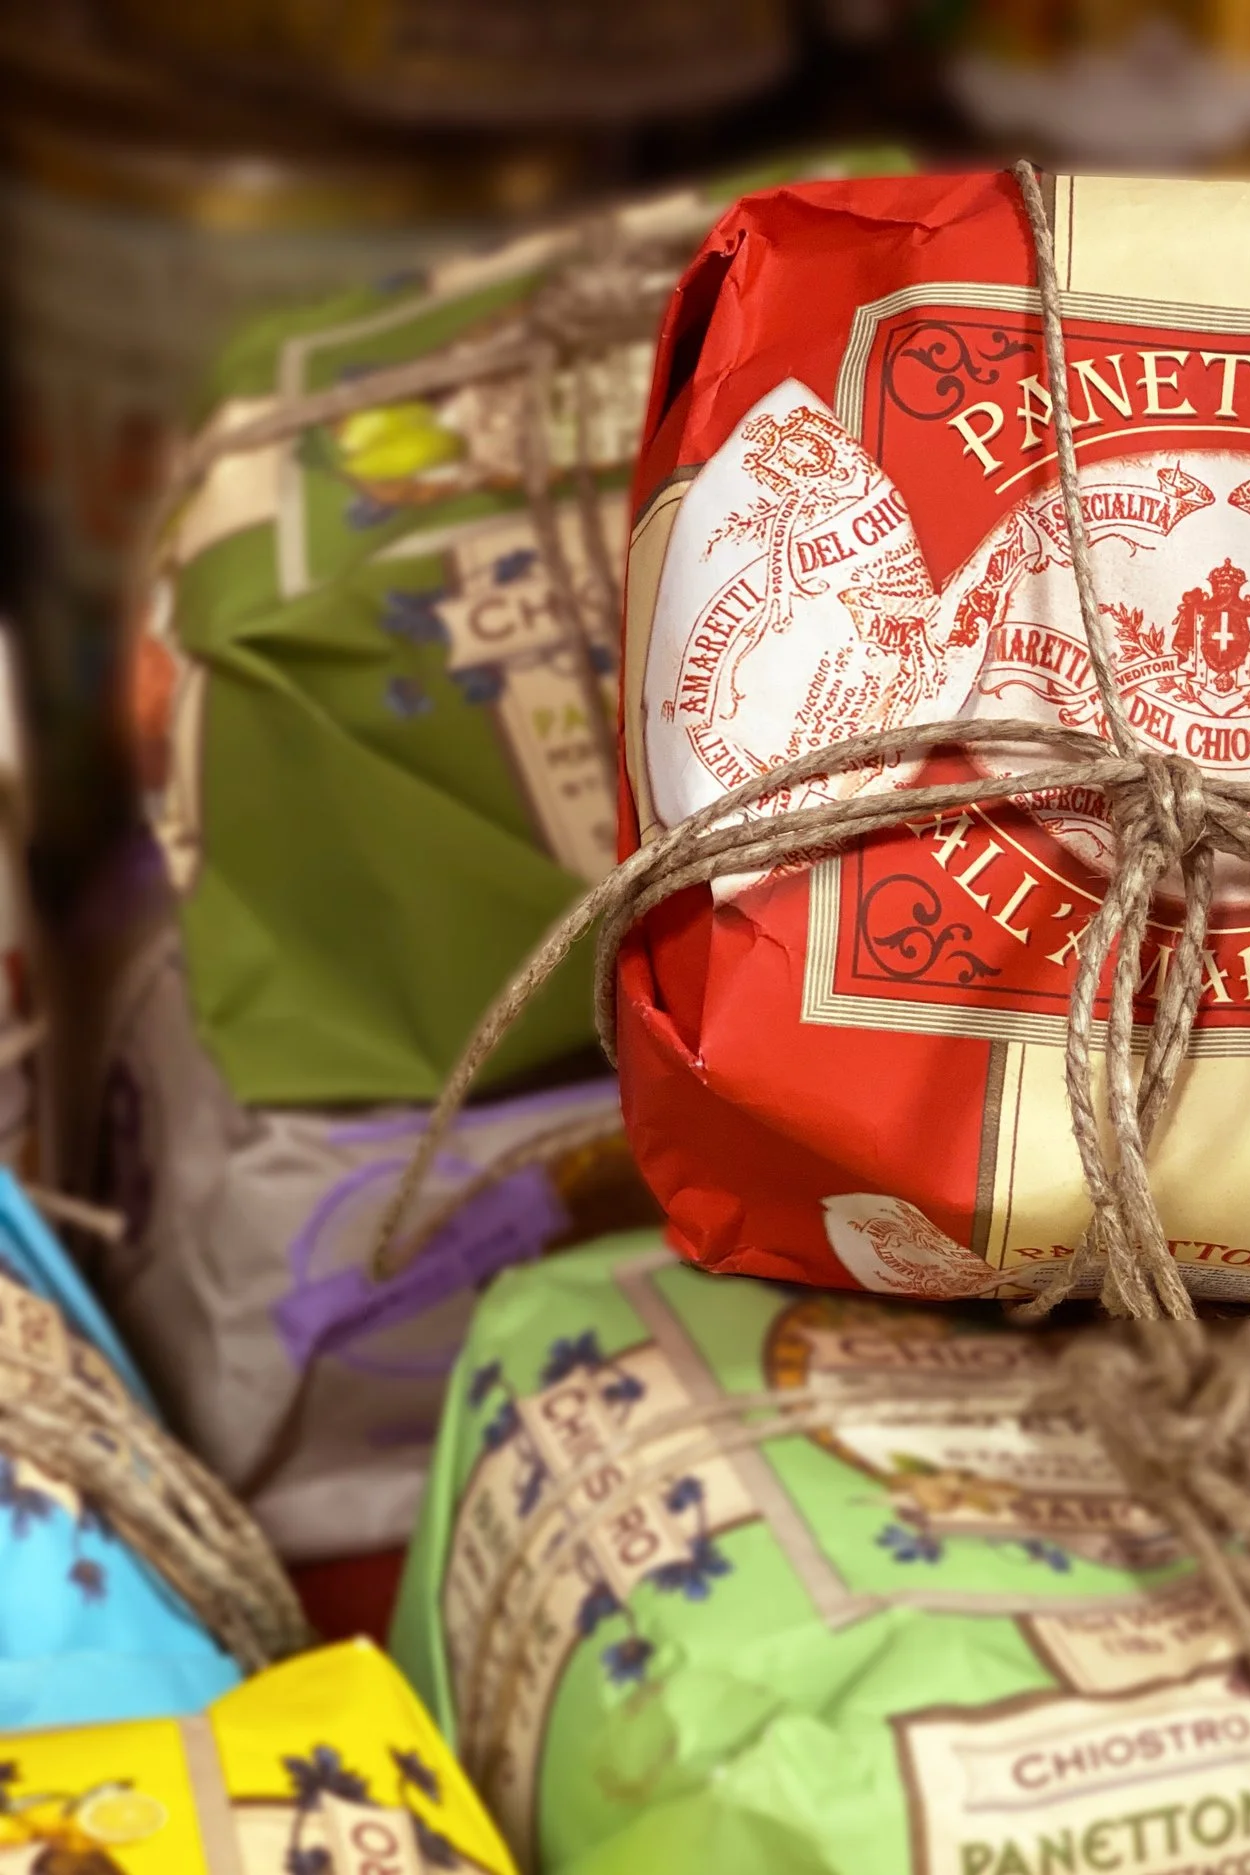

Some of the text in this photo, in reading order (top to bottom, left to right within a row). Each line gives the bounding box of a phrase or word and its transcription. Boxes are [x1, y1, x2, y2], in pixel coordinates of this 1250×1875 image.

[1052, 492, 1171, 531] SECIALITÀ
[795, 531, 859, 574] DEL
[679, 578, 764, 714] AMARETTI
[1128, 695, 1178, 750] DEL
